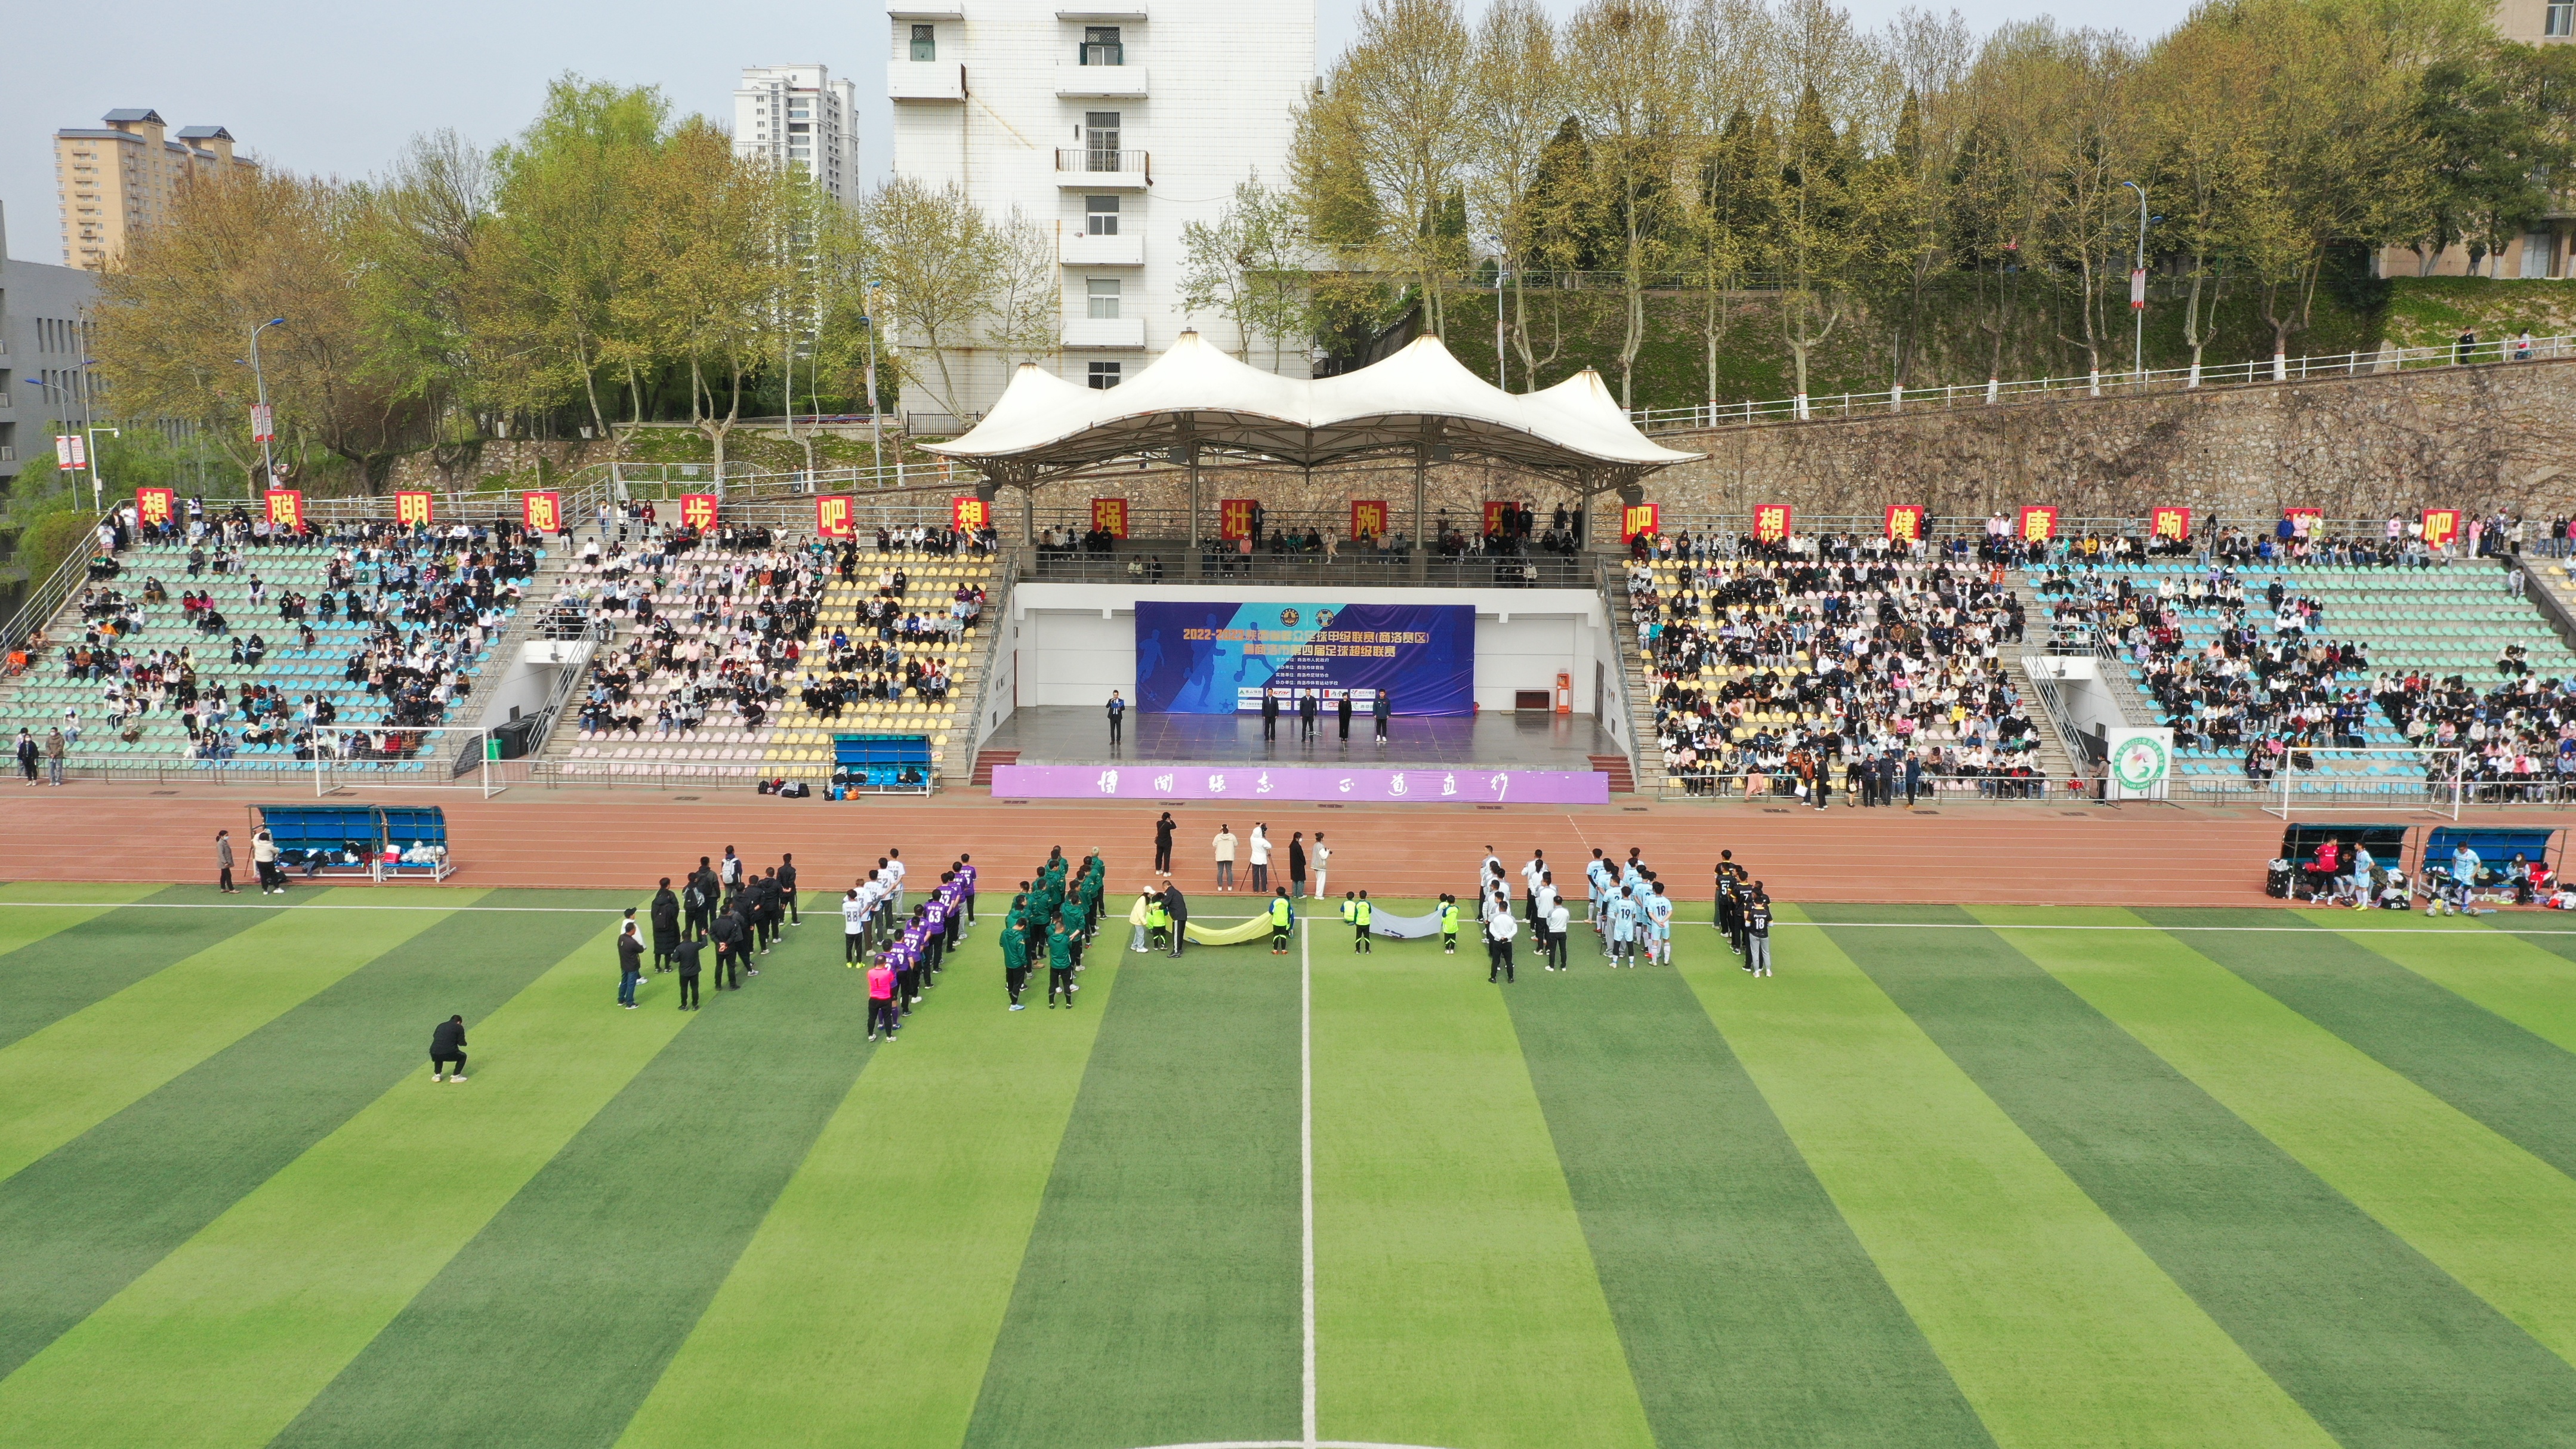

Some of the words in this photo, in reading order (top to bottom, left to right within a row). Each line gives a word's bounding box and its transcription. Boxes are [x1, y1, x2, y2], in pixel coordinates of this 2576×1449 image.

[142, 492, 168, 529] 想
[269, 495, 297, 528] 聪
[400, 495, 429, 529] 明
[529, 497, 556, 530] 跑
[685, 498, 712, 532] 步
[821, 500, 849, 534] 吧
[957, 501, 983, 535] 想
[1097, 502, 1123, 536] 强
[1226, 503, 1252, 537] 壮
[1356, 505, 1383, 539] 跑
[1627, 506, 1653, 541] 吧
[1759, 508, 1784, 541] 想
[1890, 509, 1916, 544] 健
[2025, 510, 2051, 543] 康
[2157, 511, 2182, 541] 跑
[2425, 513, 2453, 548] 吧
[846, 911, 858, 922] 88
[928, 910, 942, 923] 63
[1621, 908, 1631, 920] 19
[1656, 905, 1666, 917] 18
[1755, 918, 1765, 930] 18
[874, 978, 880, 989] 1
